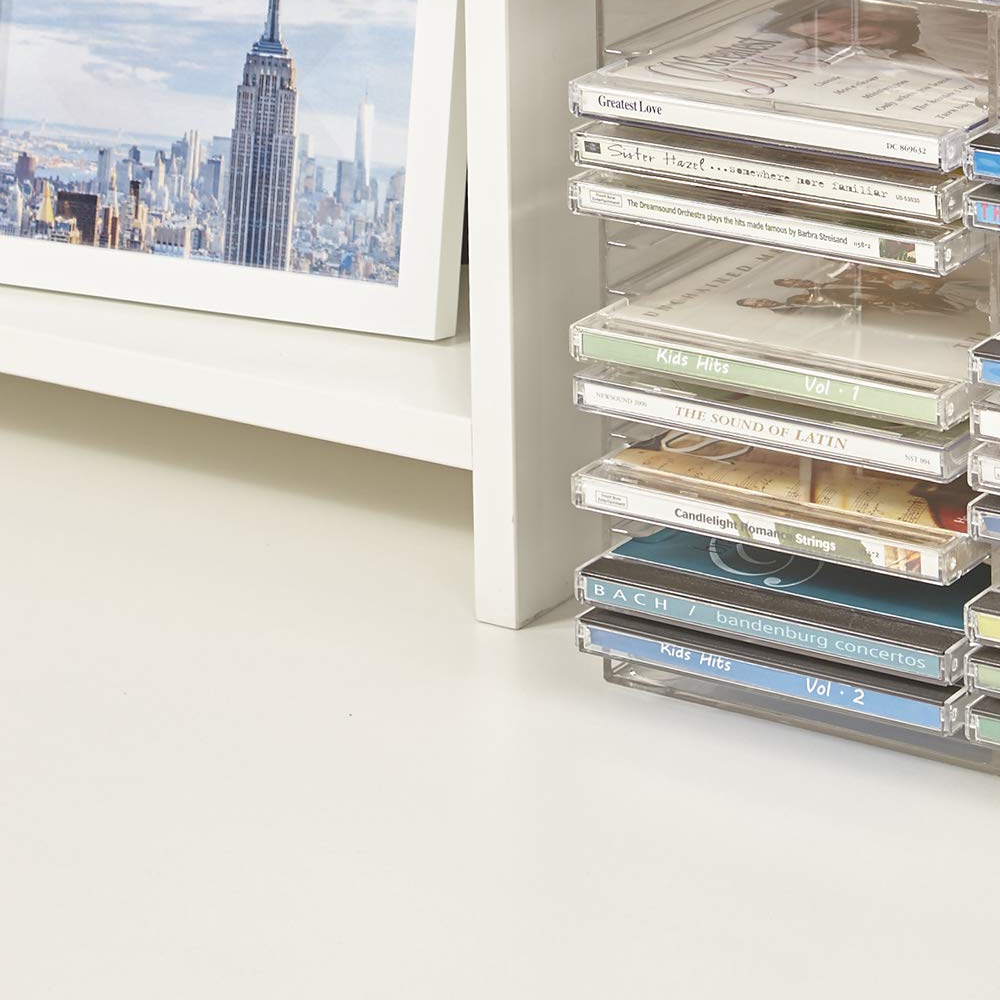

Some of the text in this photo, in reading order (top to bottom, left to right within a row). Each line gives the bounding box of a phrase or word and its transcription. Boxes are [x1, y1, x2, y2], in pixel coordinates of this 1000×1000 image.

[598, 94, 638, 113] Greatest
[639, 100, 663, 116] Love
[608, 145, 655, 165] Sister
[663, 150, 705, 173] Hazel
[797, 176, 824, 188] more
[832, 179, 888, 199] familiar
[675, 404, 847, 451] THE SOUND OF LATIN
[675, 507, 737, 532] Candlelight
[795, 532, 837, 552] Strings
[593, 584, 927, 669] BACH bandenburg concertos
[660, 641, 865, 706] Kids Hits Vol 2
